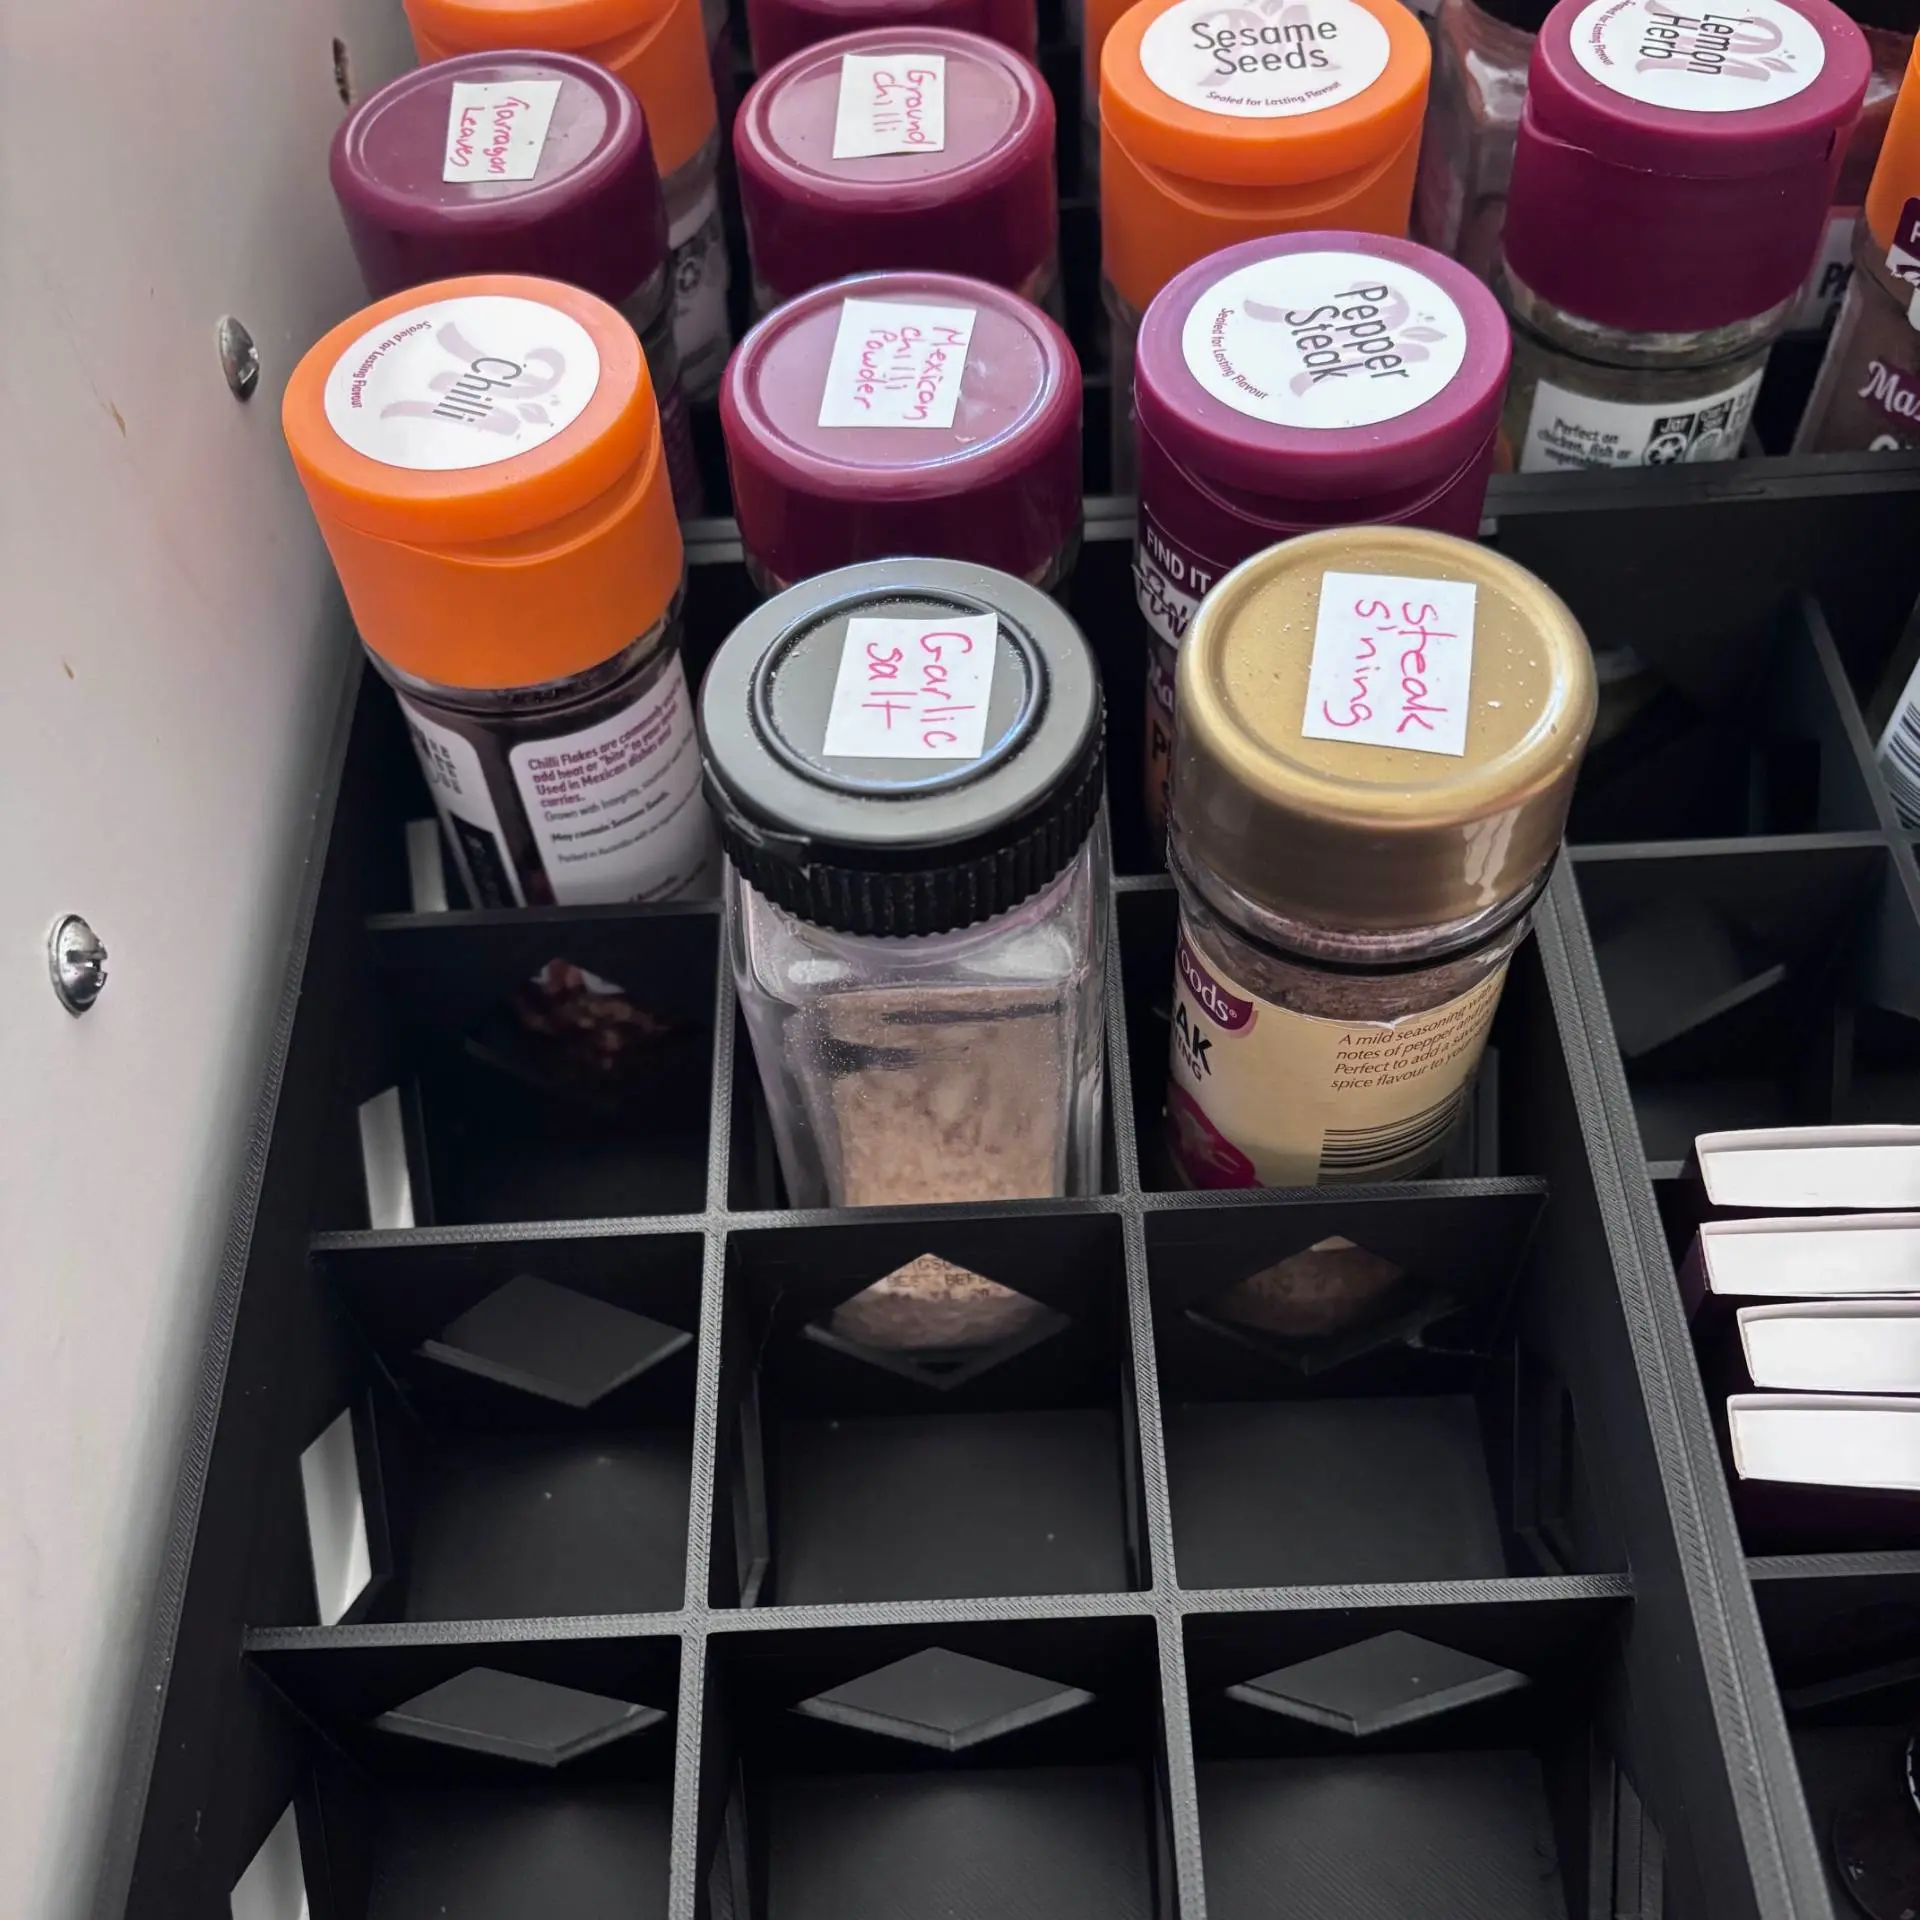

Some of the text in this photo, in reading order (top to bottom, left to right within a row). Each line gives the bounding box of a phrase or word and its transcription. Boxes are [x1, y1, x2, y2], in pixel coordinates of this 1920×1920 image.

[1191, 21, 1338, 50] Sesame
[1639, 13, 1701, 59] Herb
[1686, 14, 1754, 75] Lemon
[1212, 43, 1329, 75] Seeds
[902, 70, 937, 145] Ground
[1206, 91, 1245, 105] Sealed
[1245, 97, 1262, 106] for
[1265, 95, 1306, 106] Lasting
[378, 339, 396, 352] for
[392, 320, 432, 342] Sealed
[1285, 305, 1364, 384] Steak
[1334, 285, 1410, 379] Pepper
[352, 350, 384, 379] Lasting
[1211, 307, 1269, 400] Sealed for Lasting Flavour
[432, 357, 523, 423] Chilli
[902, 326, 967, 421] Mexican
[1146, 525, 1212, 595] FIND IT
[1397, 602, 1458, 733] Steak
[919, 632, 974, 748] Garlic
[528, 755, 561, 771] Chilli
[560, 747, 599, 766] Flakes
[535, 779, 567, 797] Used
[568, 779, 582, 791] in
[580, 761, 629, 789] Mexican
[1336, 1049, 1381, 1061] notes
[1384, 1043, 1402, 1058] of
[1400, 1026, 1457, 1061] pepper
[1338, 1033, 1351, 1046] A
[1356, 1030, 1394, 1046] mild
[1395, 1008, 1467, 1042] seasoning
[1331, 1075, 1374, 1092] spice
[1376, 1063, 1429, 1087] flavour
[1430, 1057, 1445, 1072] to
[1334, 1062, 1392, 1076] Perfect
[1393, 1057, 1408, 1070] to
[1410, 1045, 1444, 1066] add
